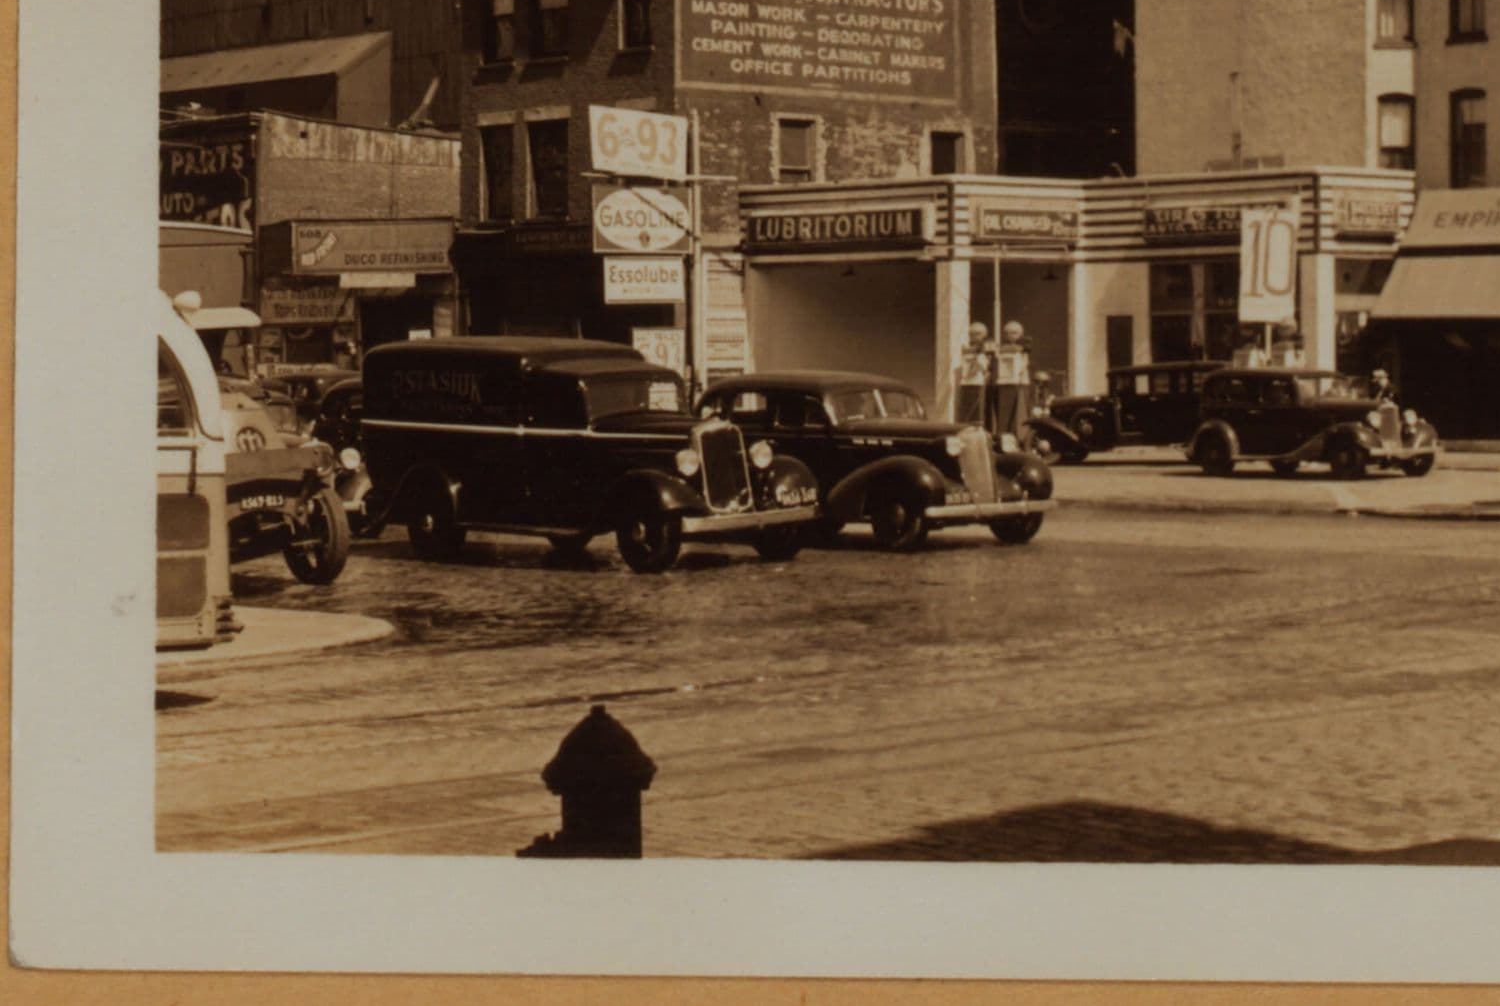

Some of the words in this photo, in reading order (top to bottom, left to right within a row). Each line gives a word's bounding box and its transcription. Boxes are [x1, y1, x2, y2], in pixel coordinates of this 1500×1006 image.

[692, 0, 749, 18] MASON
[756, 3, 806, 22] WORK
[711, 19, 796, 40] PAINTING
[817, 28, 924, 51] DECORATING
[692, 37, 753, 54] CEMENT
[760, 43, 802, 58] WORK
[817, 47, 880, 64] CABINET
[730, 58, 793, 76] OFFICE
[802, 63, 911, 85] PARTITIONS
[171, 143, 244, 176] PARTS
[159, 192, 195, 214] UTO
[756, 213, 912, 241] LUBRITORIUM
[344, 252, 377, 266] DUCO
[380, 250, 445, 266] REFINISHING
[608, 265, 679, 283] Essolube
